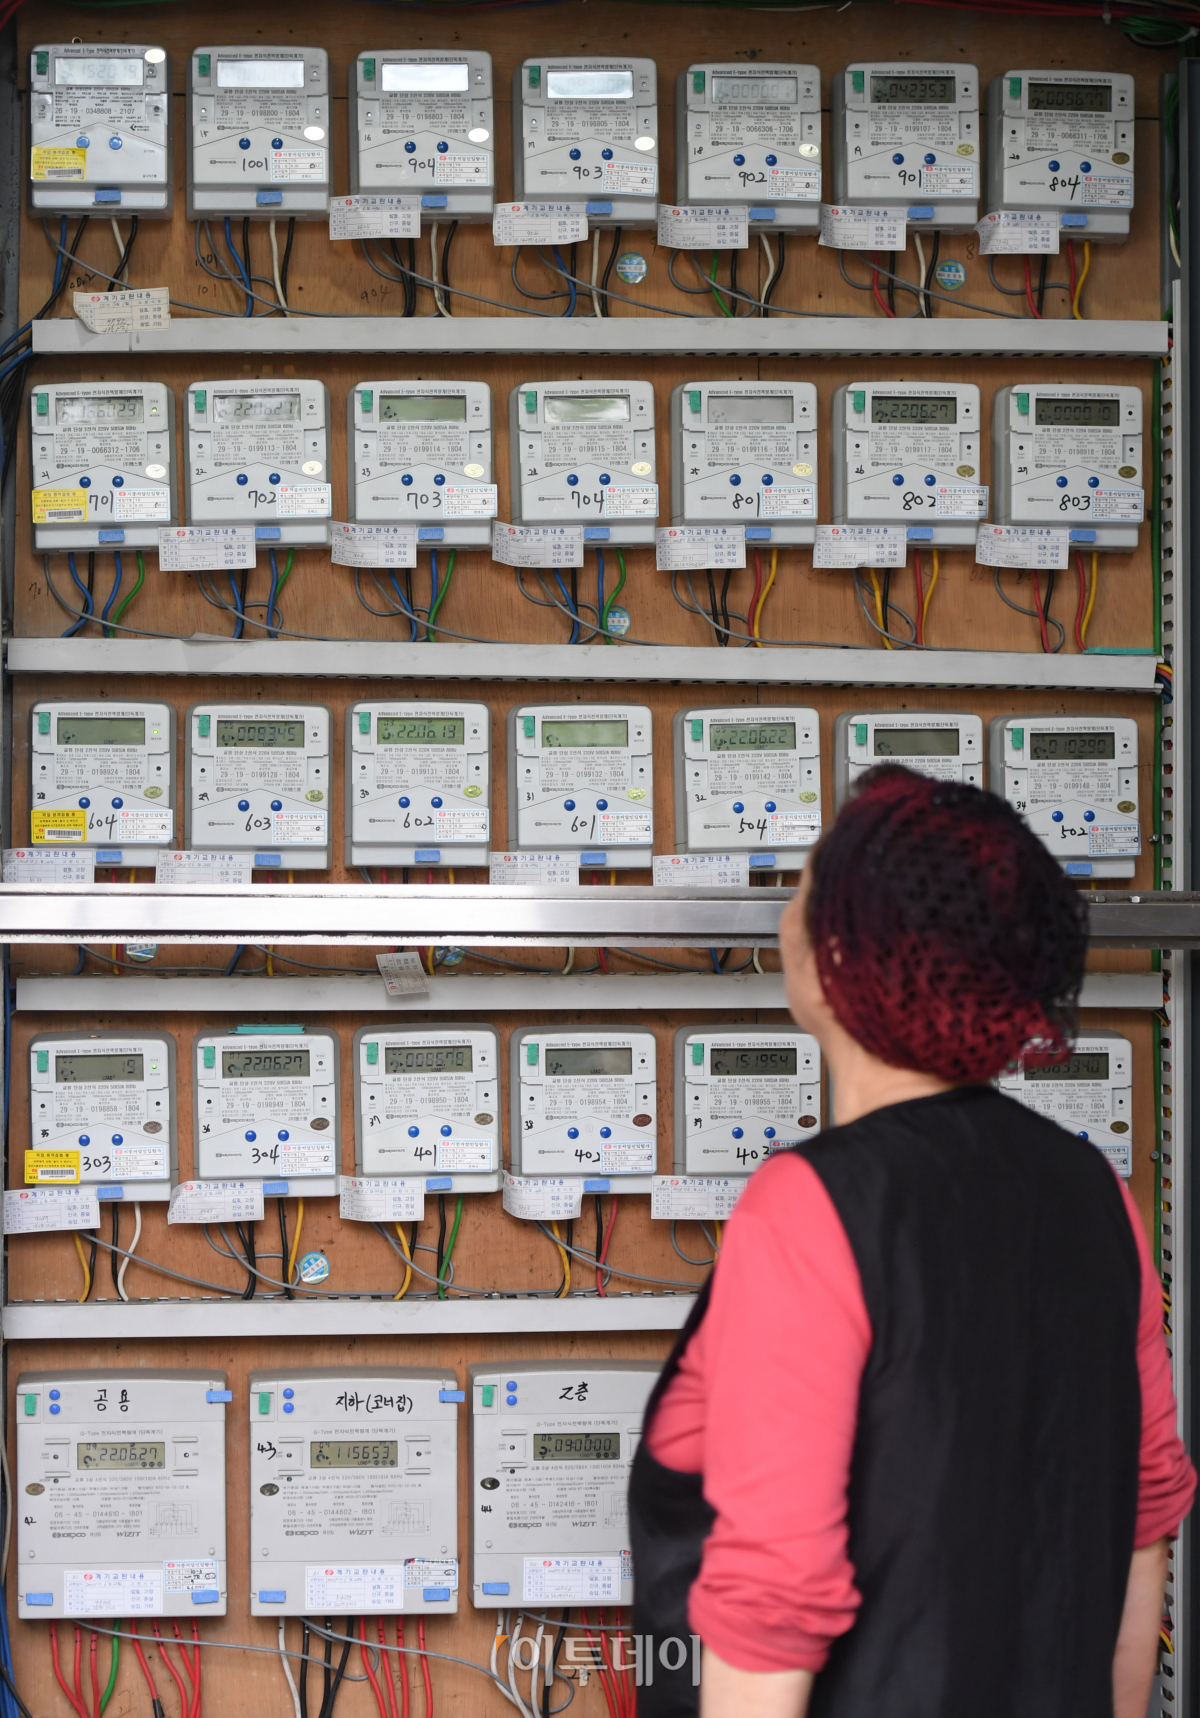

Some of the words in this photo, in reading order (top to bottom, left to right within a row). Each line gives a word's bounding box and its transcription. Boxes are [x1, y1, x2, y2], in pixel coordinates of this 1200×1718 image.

[120, 107, 135, 115] 2107
[285, 109, 300, 117] 1804
[450, 113, 465, 121] 1804
[778, 125, 794, 133] 1706
[937, 125, 952, 133] 1804
[693, 146, 704, 155] 18
[242, 157, 269, 172] 1001
[408, 158, 435, 178] 904
[572, 165, 604, 181] 903
[738, 171, 768, 187] 902
[898, 169, 922, 189] 901
[1049, 174, 1081, 200] 804
[125, 445, 140, 453] 1706
[281, 444, 297, 452] 1804
[361, 468, 371, 477] 23
[854, 465, 865, 475] 26
[89, 490, 114, 513] 701
[248, 491, 277, 508] 702
[406, 491, 442, 509] 703
[571, 490, 605, 513] 704
[732, 492, 761, 518] 801
[902, 492, 936, 511] 802
[1059, 494, 1091, 511] 803
[125, 768, 141, 776] 1804
[284, 771, 300, 779] 1804
[609, 770, 625, 778] 1804
[777, 772, 793, 780] 1804
[359, 789, 370, 799] 30
[526, 792, 535, 801] 31
[694, 793, 707, 802] 32
[1016, 801, 1027, 811] 34
[88, 812, 117, 840] 604
[245, 813, 272, 832] 603
[403, 812, 434, 829] 602
[570, 815, 596, 839] 601
[738, 818, 768, 841] 504
[1060, 828, 1088, 839] 502
[290, 1100, 306, 1108] 1804
[453, 1096, 469, 1104] 1804
[612, 1098, 628, 1106] 1804
[124, 1104, 140, 1112] 1804
[251, 1144, 280, 1165] 304
[414, 1144, 437, 1167] 401
[574, 1148, 601, 1163] 402
[736, 1146, 770, 1166] 403
[83, 1155, 112, 1174] 303
[558, 1382, 590, 1402] 2층
[336, 1445, 391, 1460] 115653
[554, 1437, 613, 1453] 09:00:00
[571, 1520, 597, 1528] WIZIT
[116, 1530, 142, 1538] WIZIT
